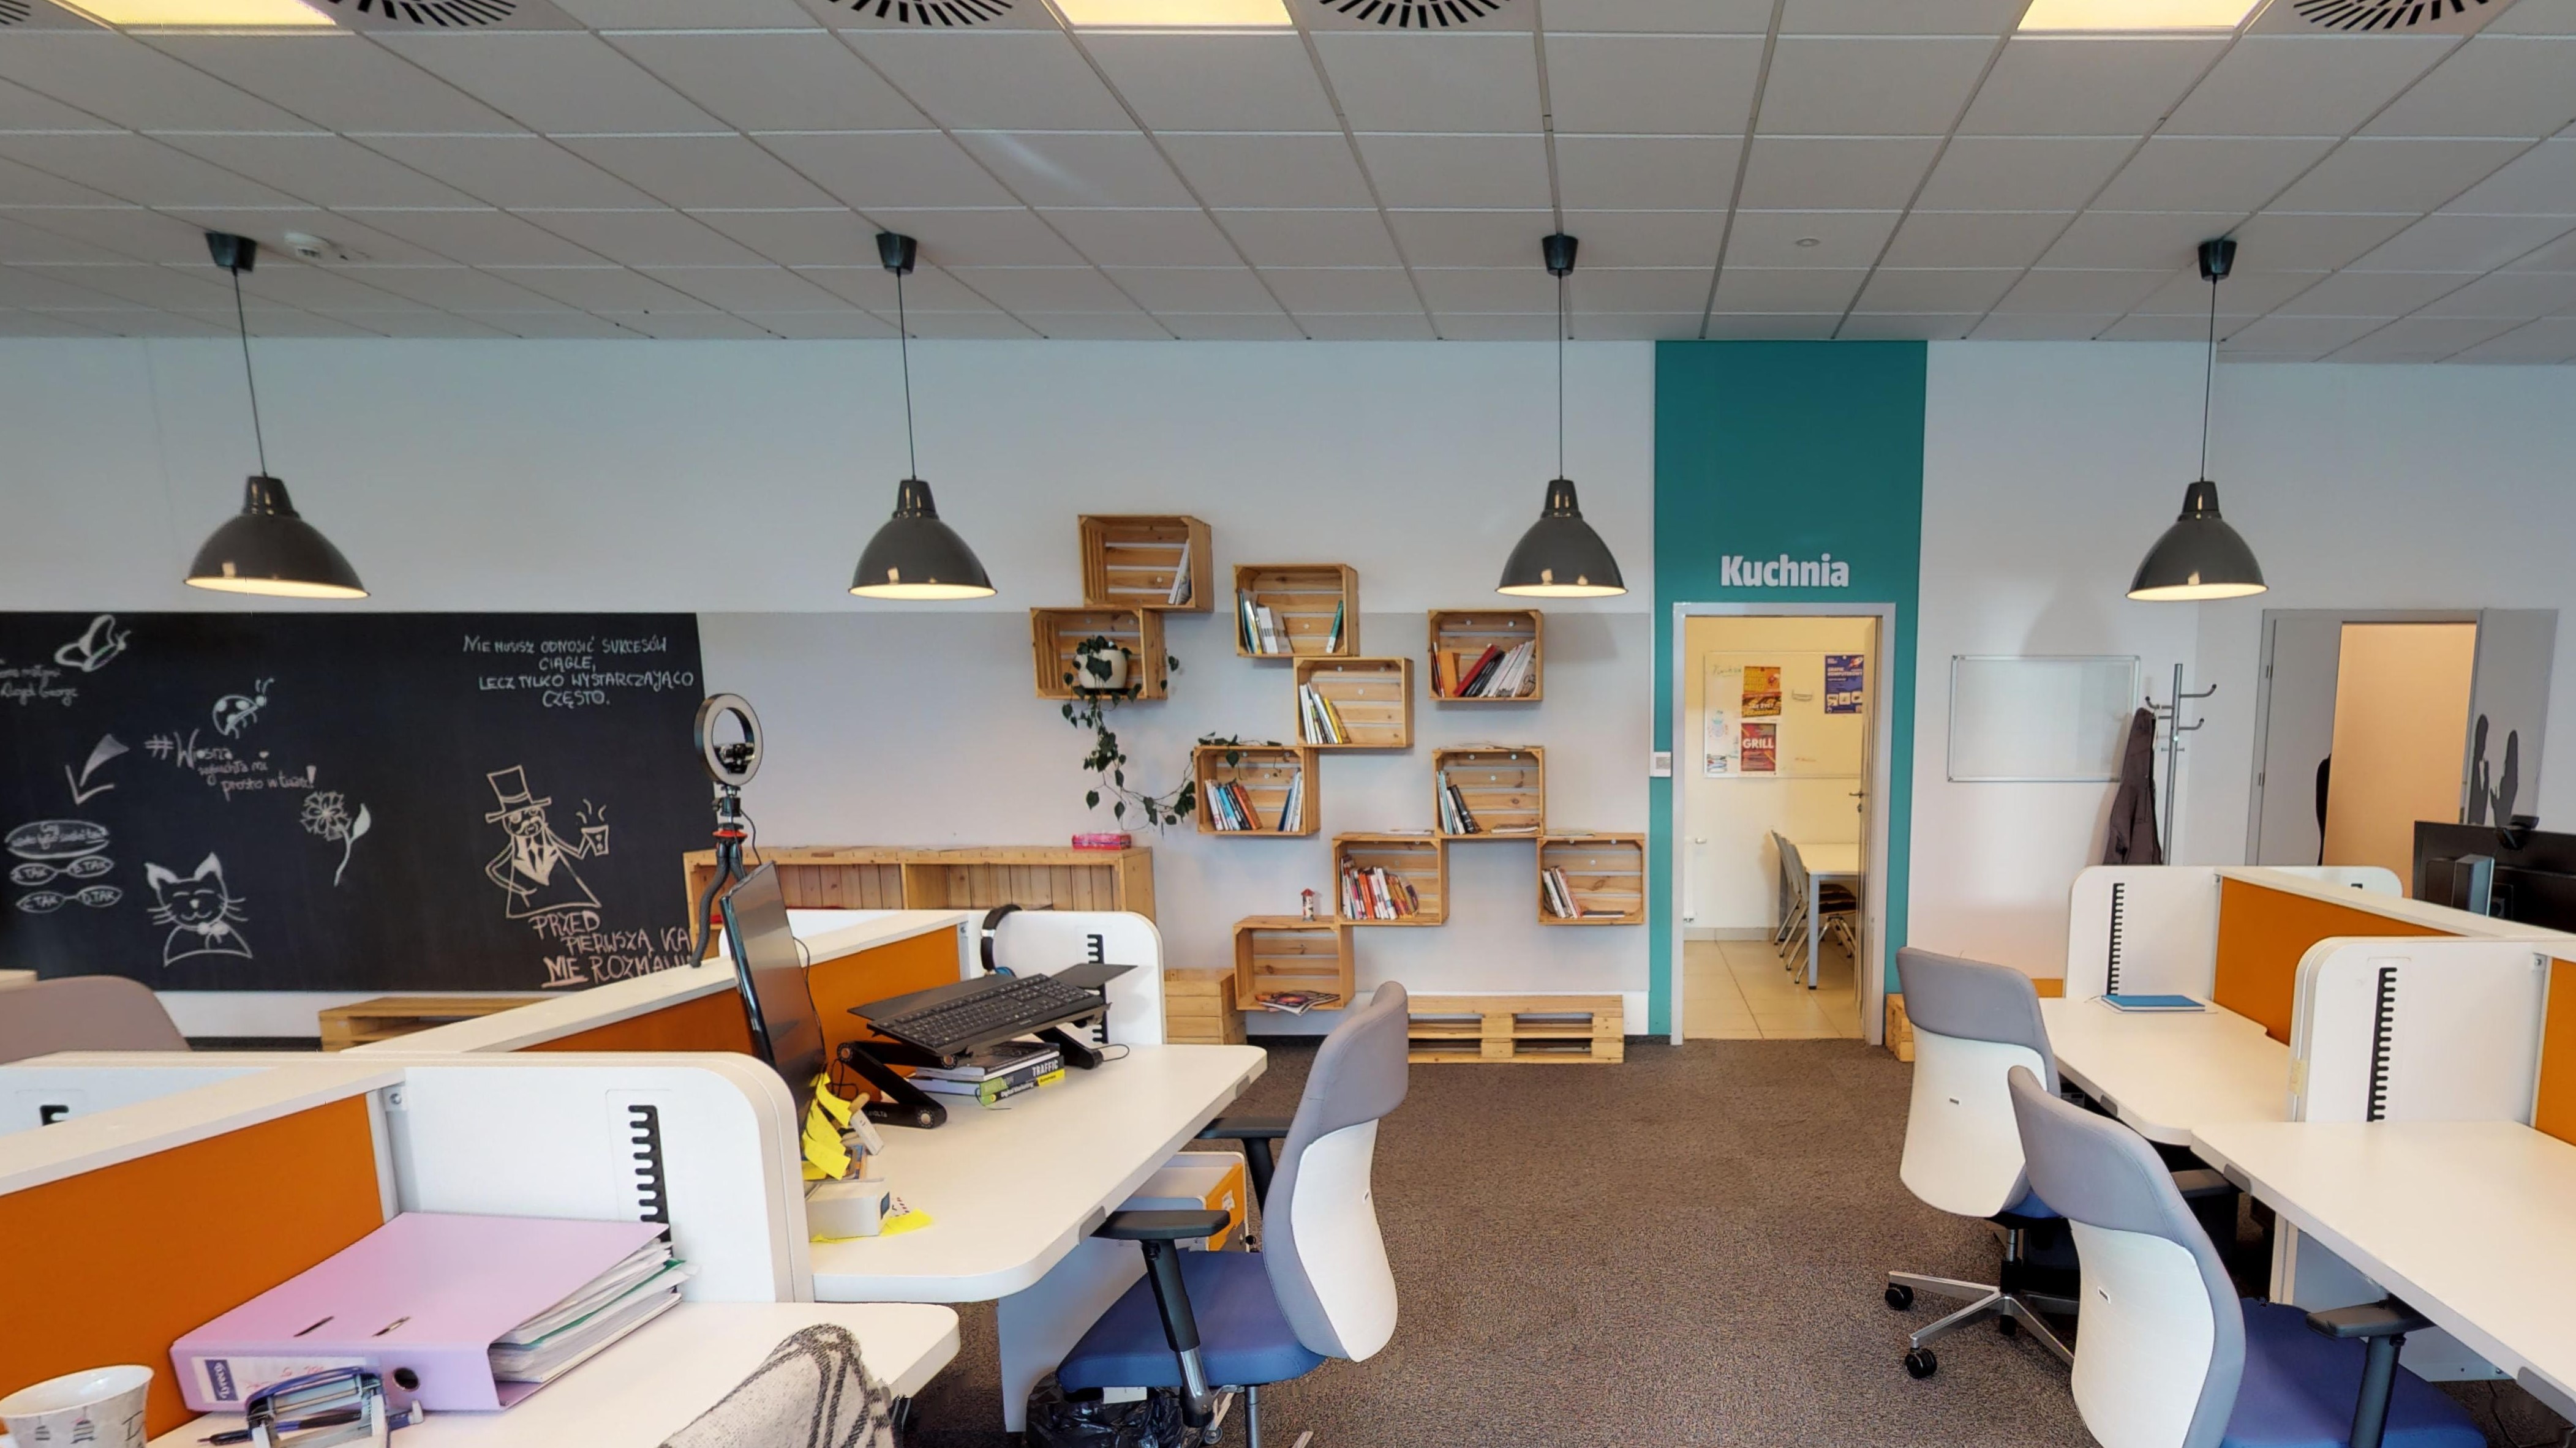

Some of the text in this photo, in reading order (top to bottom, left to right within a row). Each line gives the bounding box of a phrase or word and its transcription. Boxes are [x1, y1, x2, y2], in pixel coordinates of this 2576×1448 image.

[1721, 553, 1849, 587] Kuchnia
[541, 636, 595, 653] ODNOSIĆ
[602, 635, 666, 654] SUKCESÓW
[539, 656, 596, 672] CIĄGLE,
[480, 671, 693, 691] LECZ TYLKO WYSTARCZAJĄCO
[542, 690, 610, 708] CZĘSTO.
[1742, 738, 1774, 749] GRILL
[221, 779, 263, 802] prosto
[528, 910, 600, 940] PRZED
[560, 927, 655, 958] PIERWSZĄ
[543, 955, 582, 981] NIE
[1031, 1059, 1059, 1078] TRAFFIC
